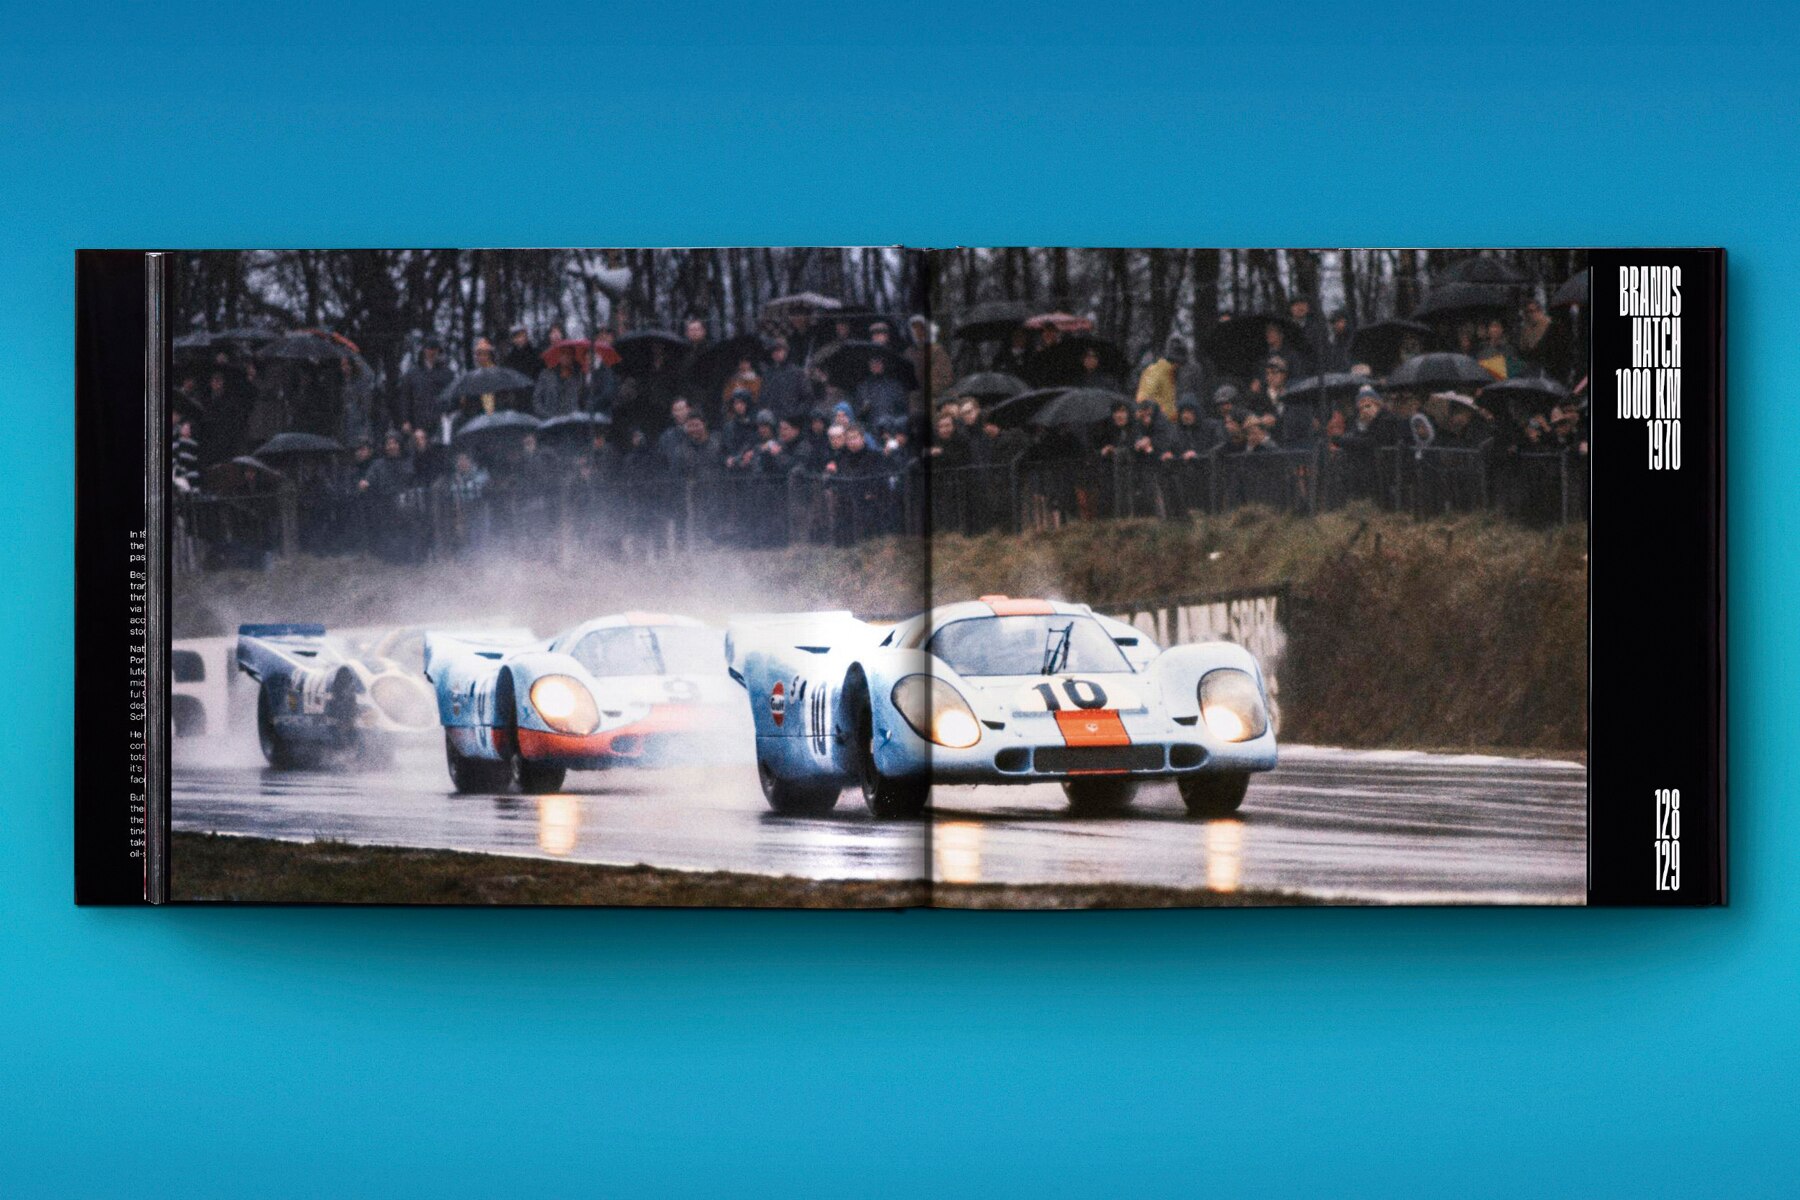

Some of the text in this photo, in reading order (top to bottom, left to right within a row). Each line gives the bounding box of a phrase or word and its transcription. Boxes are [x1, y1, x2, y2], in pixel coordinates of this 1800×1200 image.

[1619, 265, 1682, 317] BRANDS
[1632, 317, 1681, 368] HATCH
[1615, 368, 1681, 419] 1000 KM
[1647, 419, 1681, 471] 1970
[130, 690, 140, 698] ful
[1032, 679, 1108, 711] 10
[130, 764, 142, 772] it's
[130, 793, 144, 801] But
[1655, 788, 1680, 839] 128
[1654, 839, 1680, 891] 129
